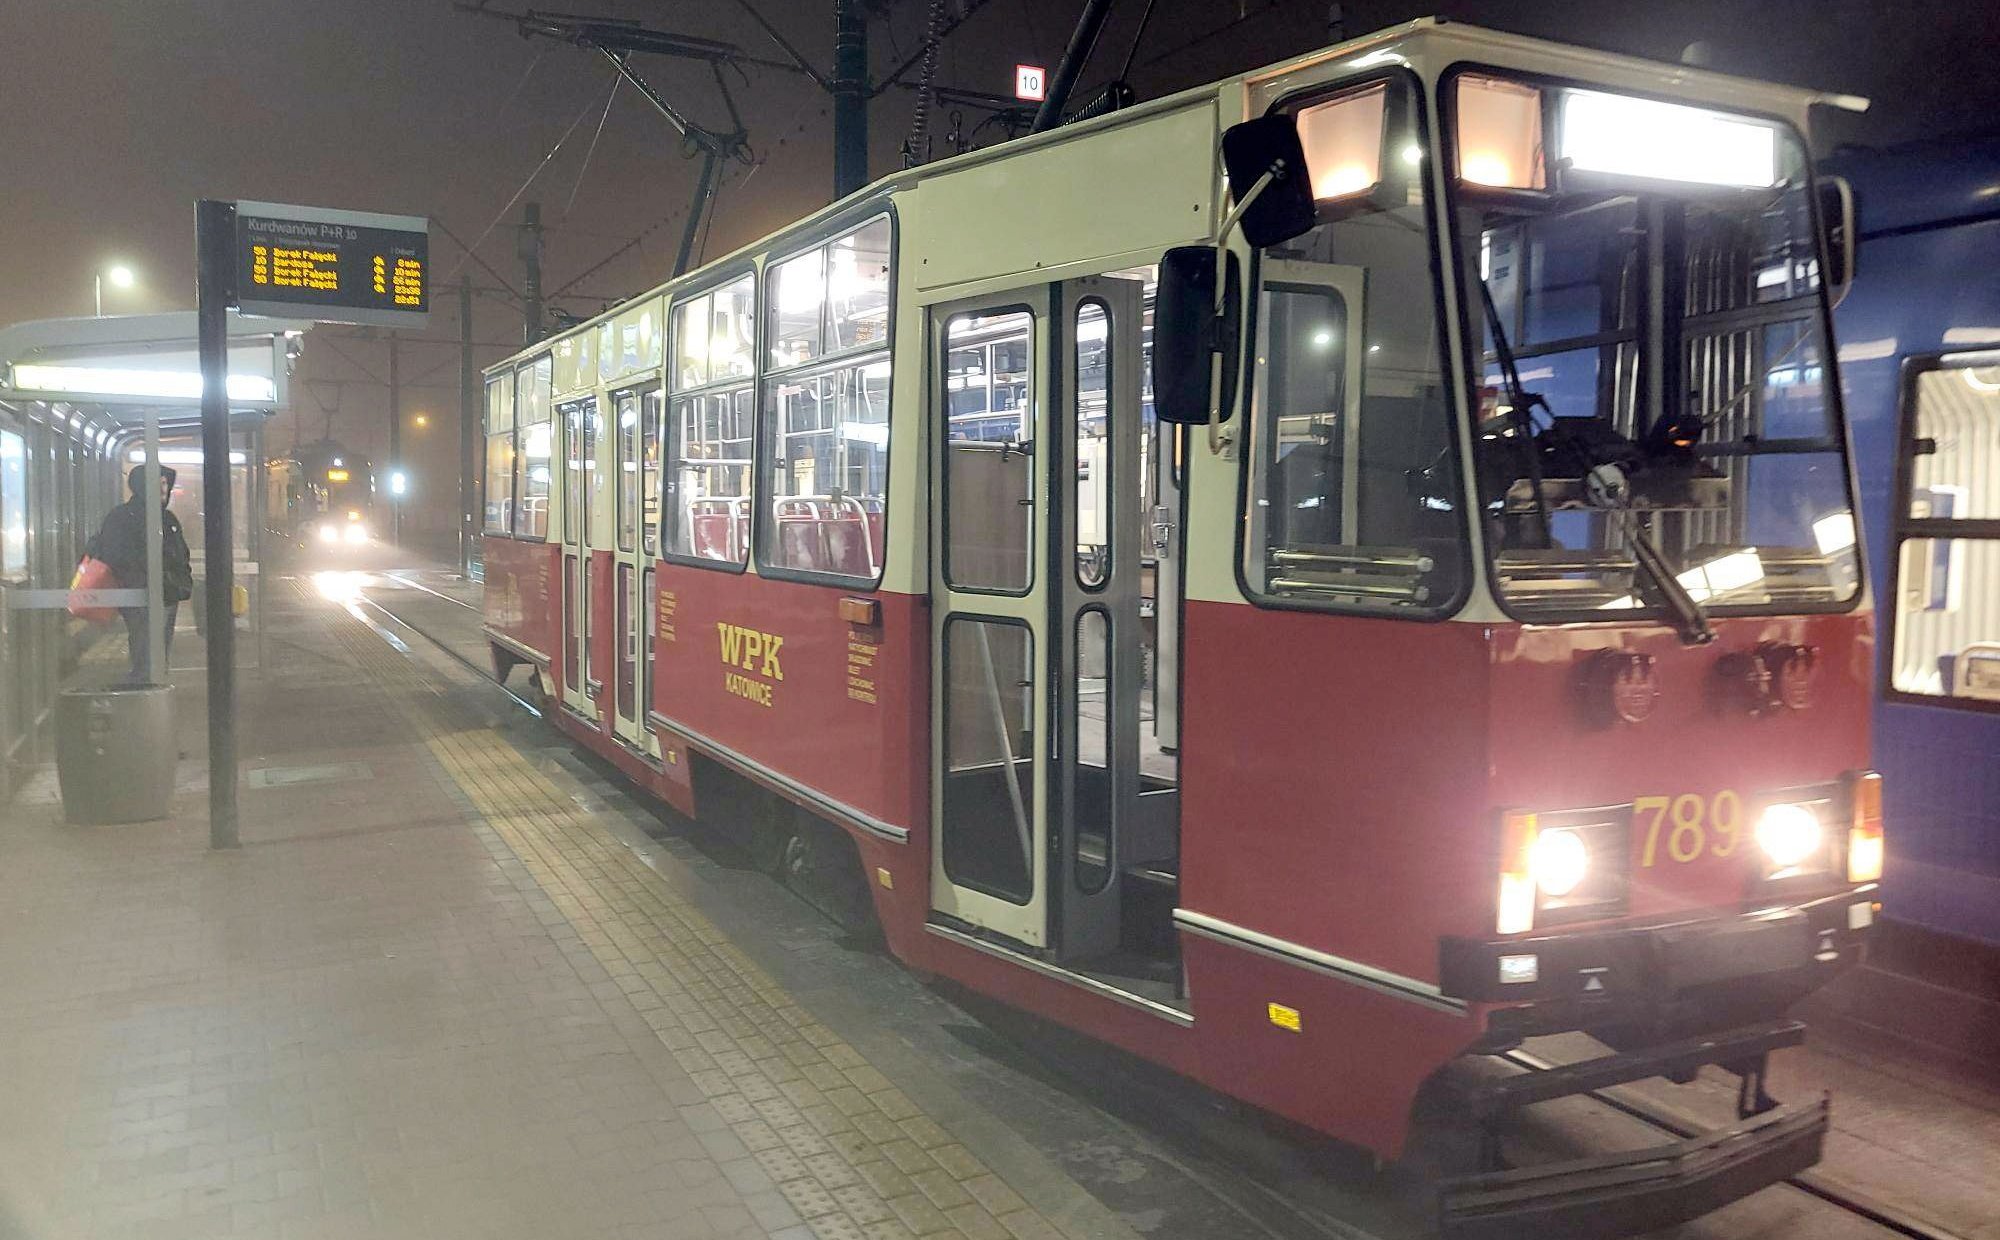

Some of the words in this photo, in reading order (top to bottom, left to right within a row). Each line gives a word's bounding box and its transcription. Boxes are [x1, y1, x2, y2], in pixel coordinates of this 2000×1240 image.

[1023, 75, 1038, 91] 10
[249, 218, 317, 236] Kurdwanów
[321, 225, 343, 239] P+R
[273, 248, 302, 258] Borek
[273, 266, 302, 277] Borek
[273, 275, 302, 286] Borek
[717, 622, 784, 681] WPK
[725, 672, 772, 707] KATOWICE
[1634, 788, 1742, 868] 789
